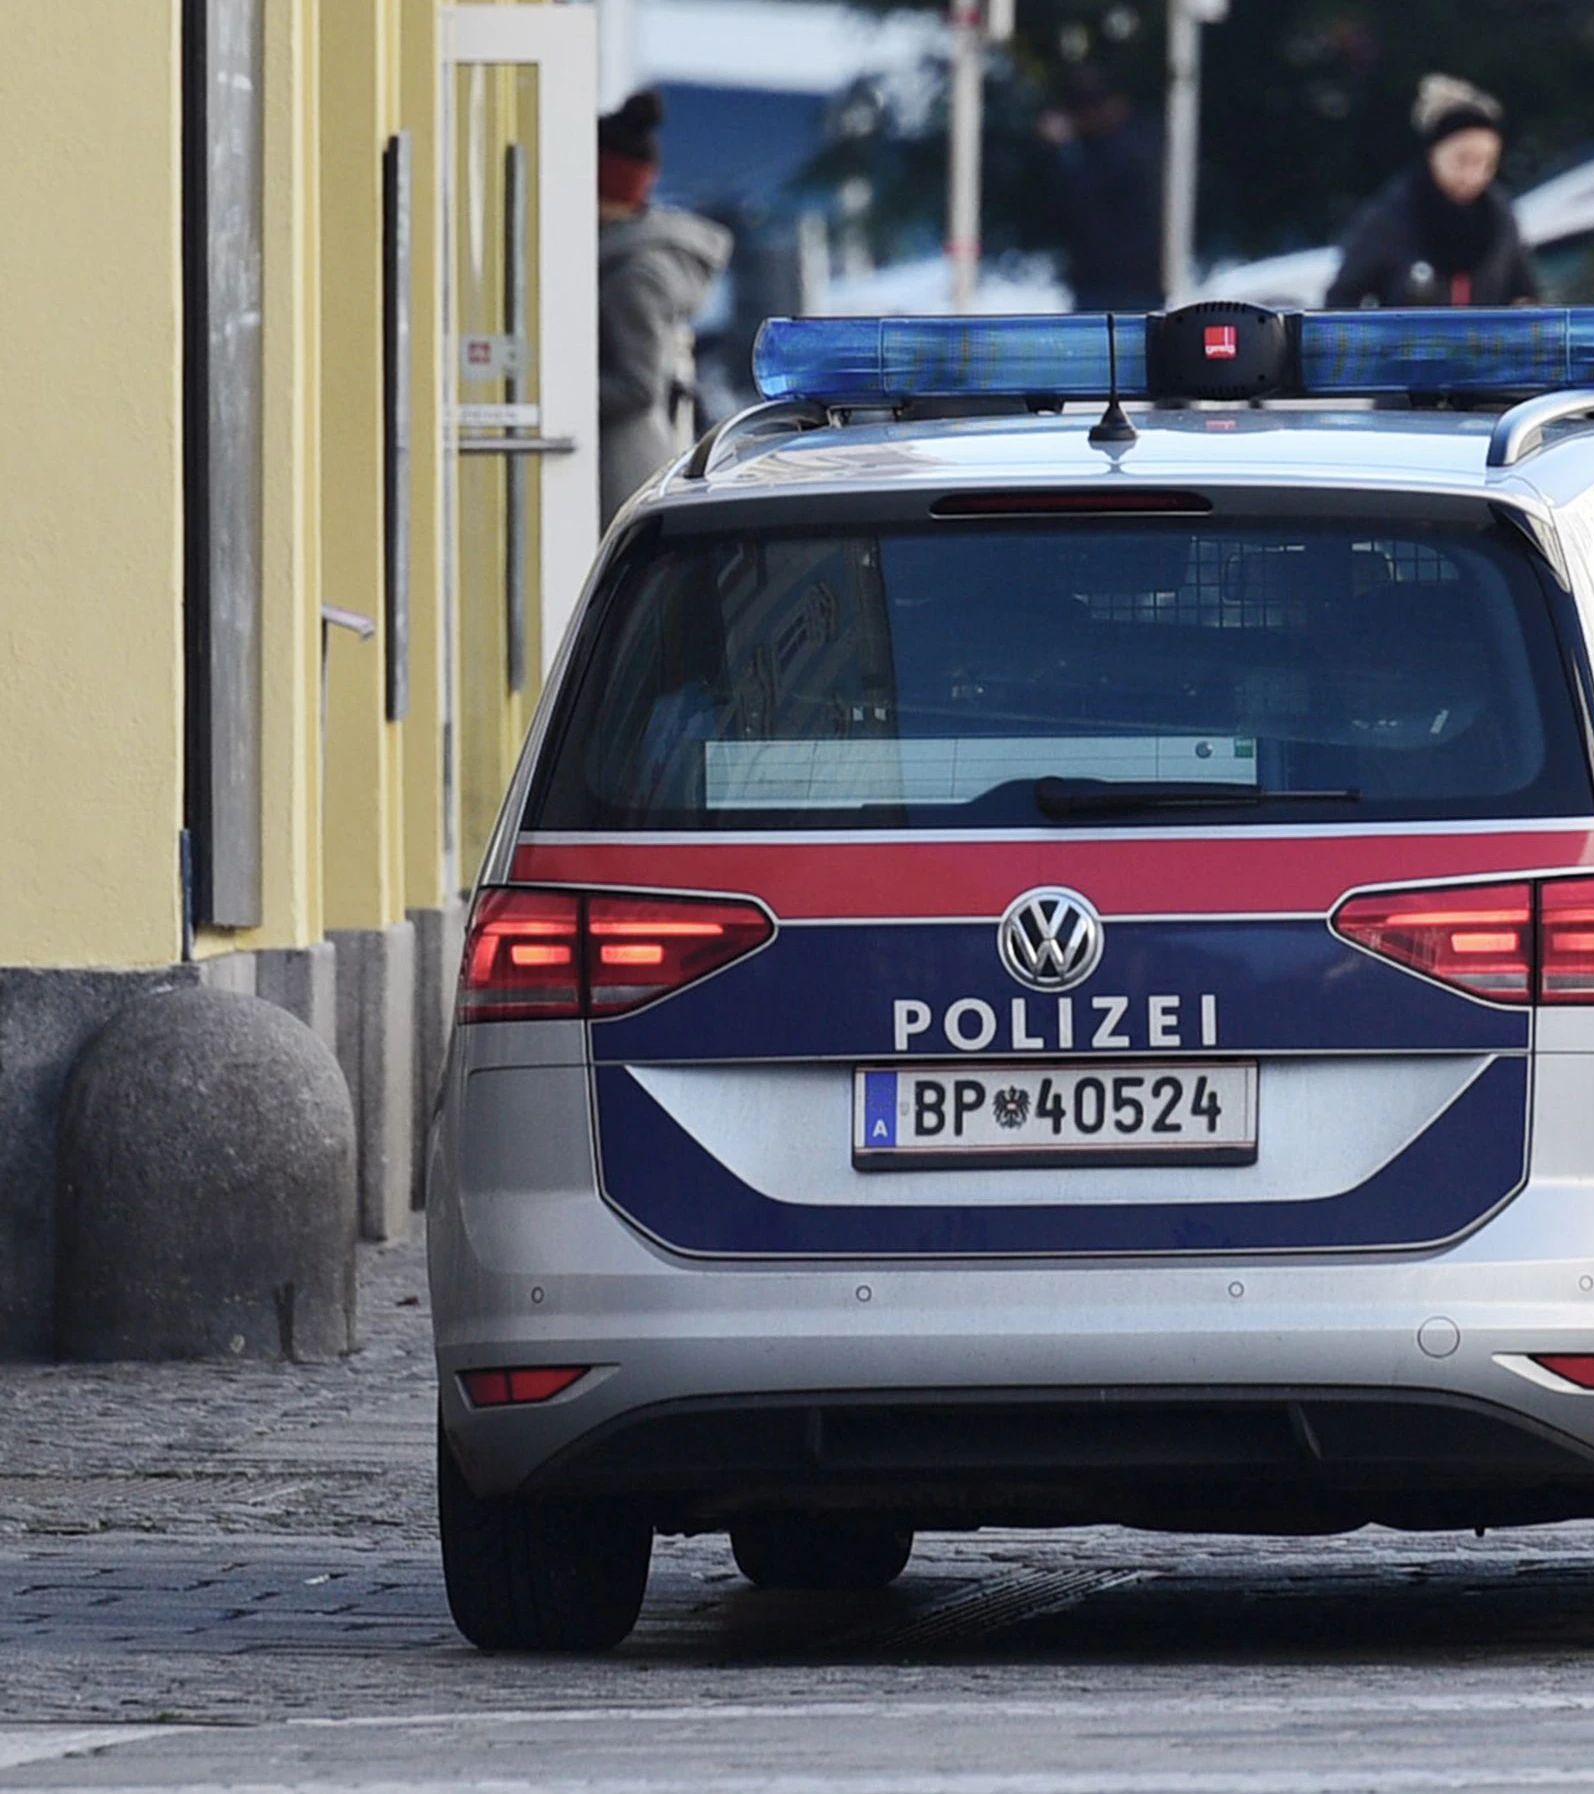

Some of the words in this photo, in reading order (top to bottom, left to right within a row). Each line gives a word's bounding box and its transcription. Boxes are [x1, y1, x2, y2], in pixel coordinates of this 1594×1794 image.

[1003, 895, 1097, 983] VW
[893, 994, 1217, 1051] POLIZEI
[872, 1118, 888, 1138] A
[914, 1080, 987, 1137] BP
[1034, 1075, 1222, 1134] 40524
